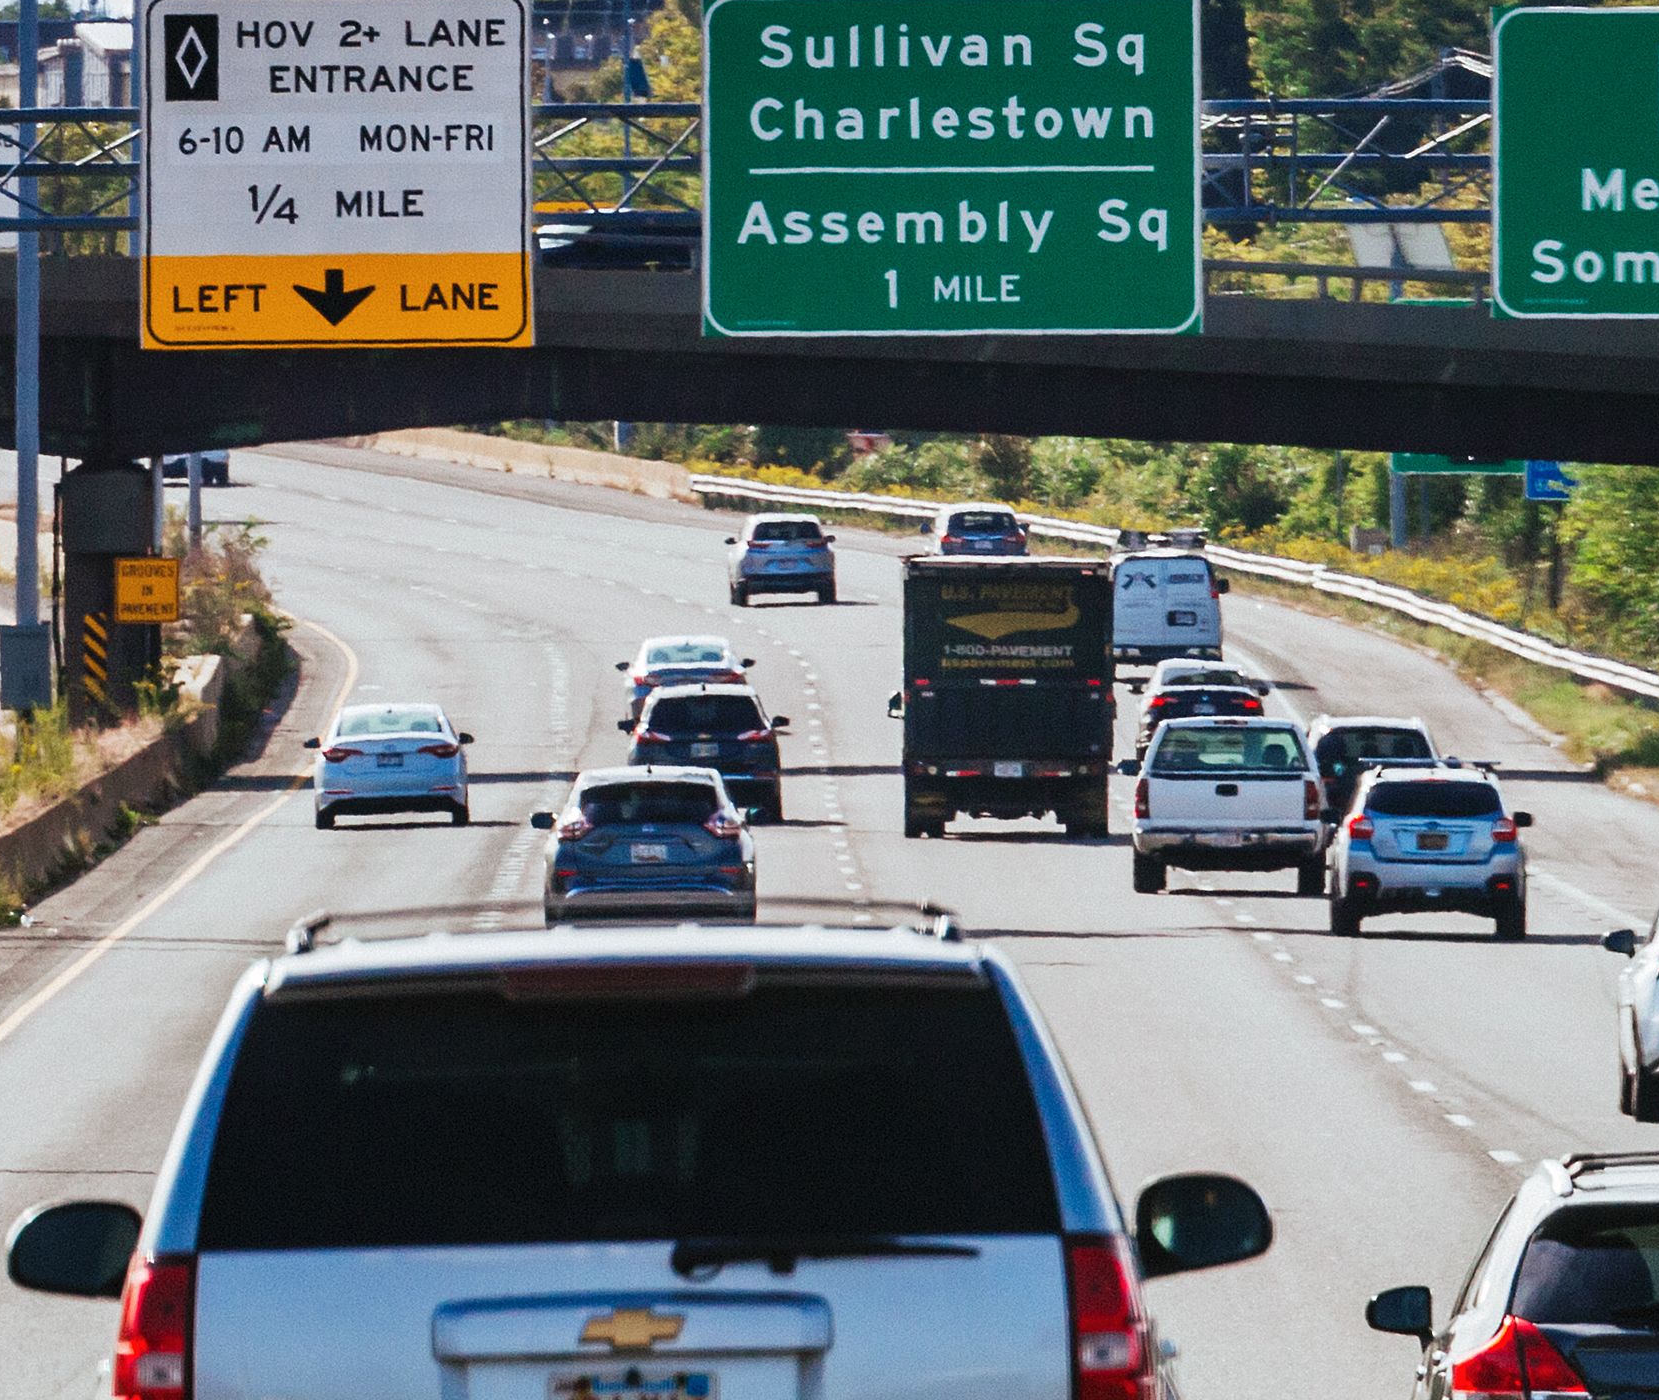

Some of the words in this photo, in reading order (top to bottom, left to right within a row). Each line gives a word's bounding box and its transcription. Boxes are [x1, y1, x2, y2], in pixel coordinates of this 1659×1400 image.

[237, 21, 313, 48] HOV
[340, 20, 380, 47] 2+
[406, 19, 505, 46] LANE
[760, 24, 1031, 68] Sullivan
[1074, 23, 1144, 75] Sq
[270, 65, 473, 93] ENTRANCE
[751, 96, 1153, 140] Charlestown
[179, 126, 243, 155] 6-10
[263, 126, 309, 152] AM
[360, 125, 492, 152] MON-FRI
[336, 190, 423, 217] MILE
[738, 201, 1053, 252] Assembly
[1098, 199, 1167, 251] Sq
[173, 284, 266, 312] LEFT
[401, 283, 498, 311] LANE
[885, 270, 897, 308] 1
[935, 275, 1020, 301] MILE
